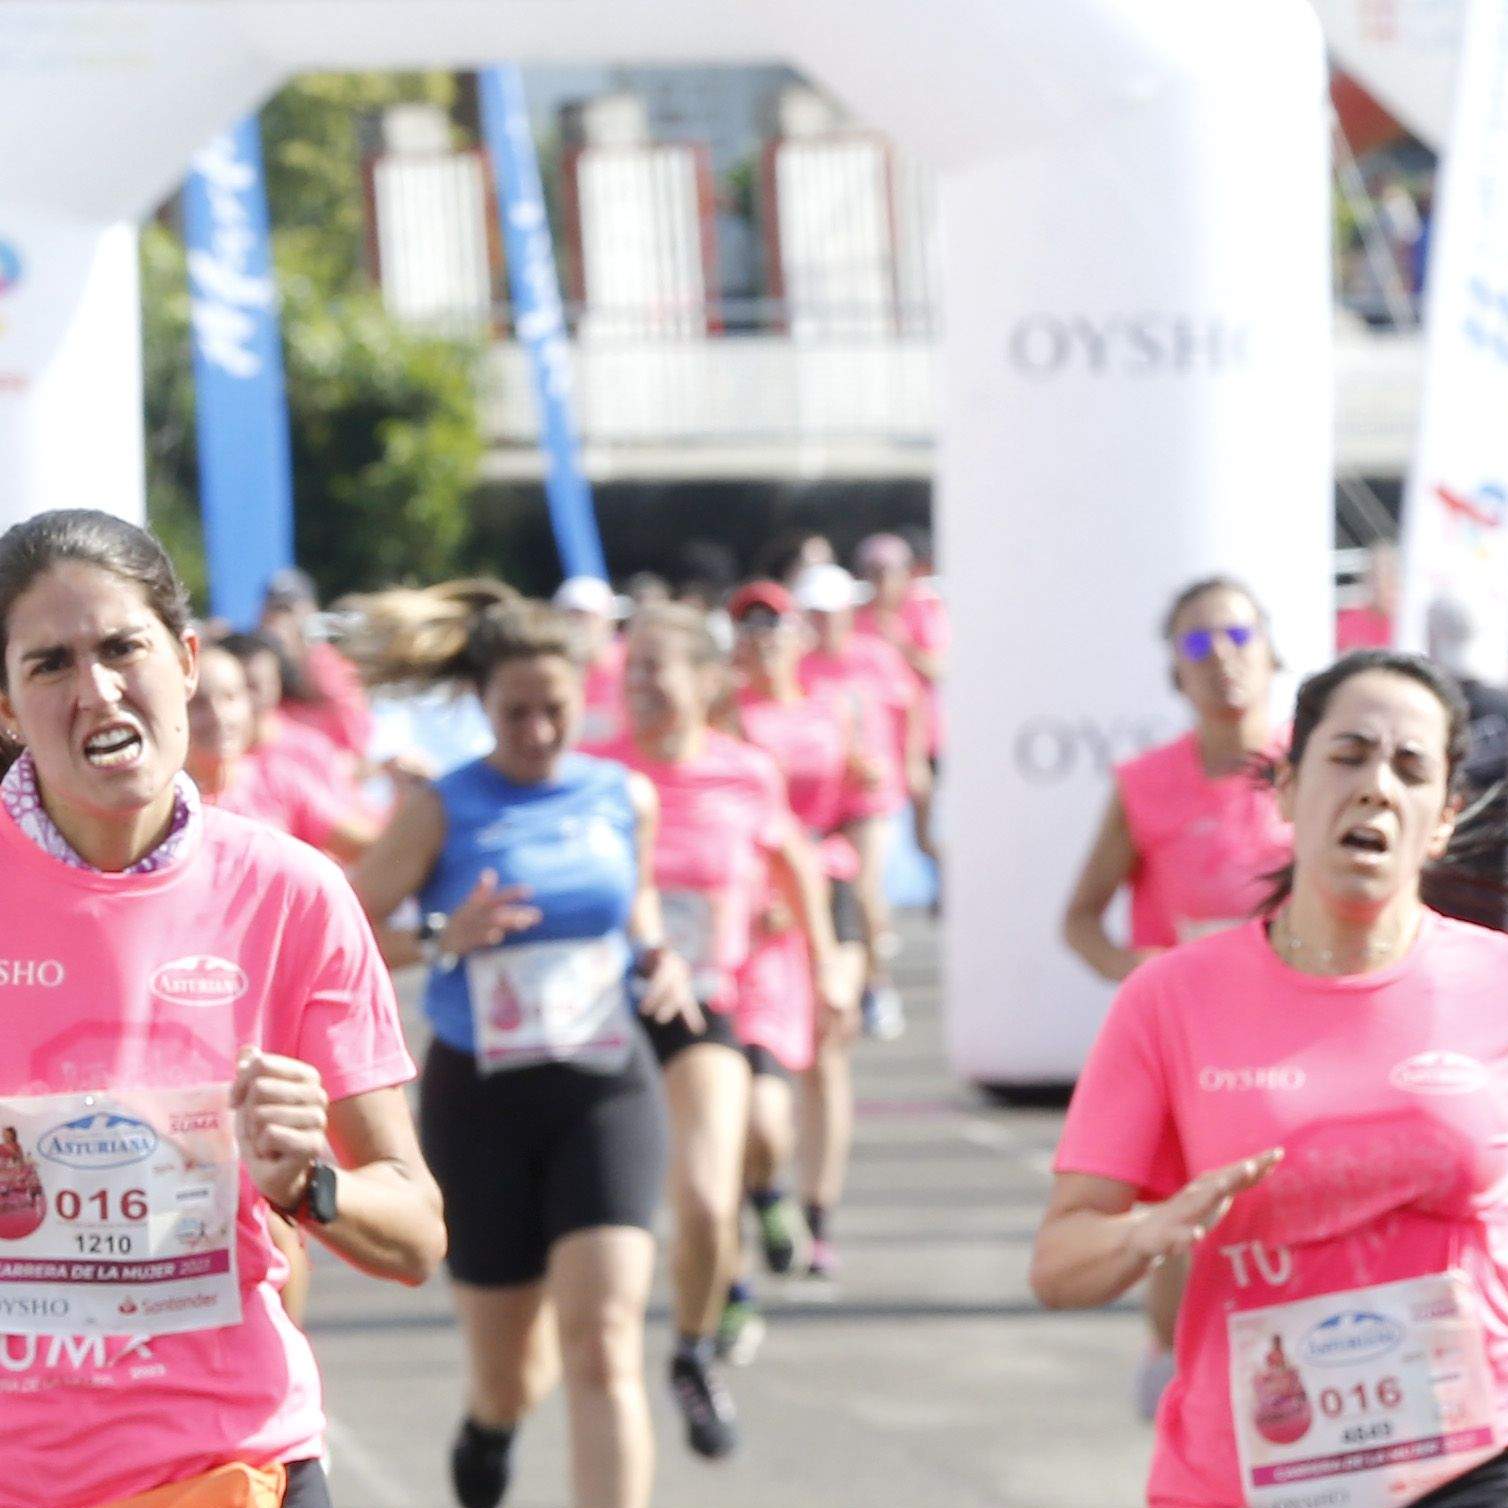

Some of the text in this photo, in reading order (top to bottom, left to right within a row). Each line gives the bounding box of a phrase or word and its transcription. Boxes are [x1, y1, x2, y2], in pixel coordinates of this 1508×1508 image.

[50, 1136, 151, 1155] ASTURIANA
[56, 1188, 148, 1220] 016
[75, 1233, 132, 1254] 1210
[97, 1266, 119, 1281] LA
[1220, 1241, 1292, 1288] TU
[1319, 1376, 1402, 1417] 016
